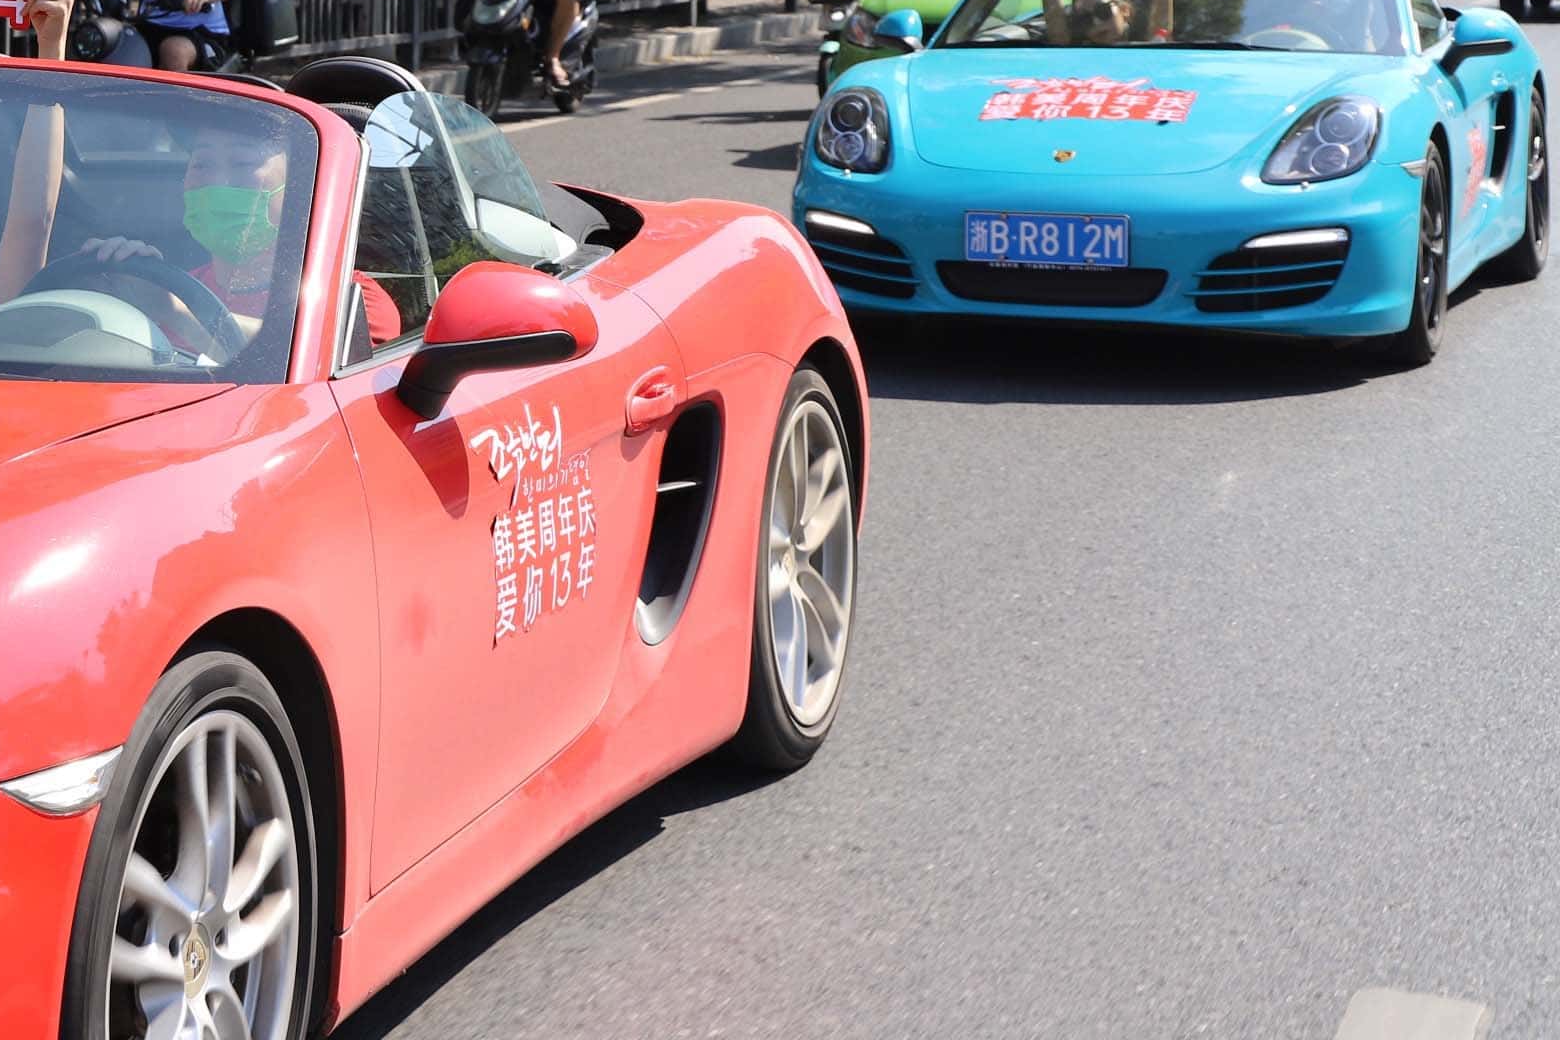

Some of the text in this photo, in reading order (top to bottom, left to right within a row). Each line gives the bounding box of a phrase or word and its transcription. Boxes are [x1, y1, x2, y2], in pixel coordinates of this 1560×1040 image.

[494, 488, 596, 573] 韩美周年庆
